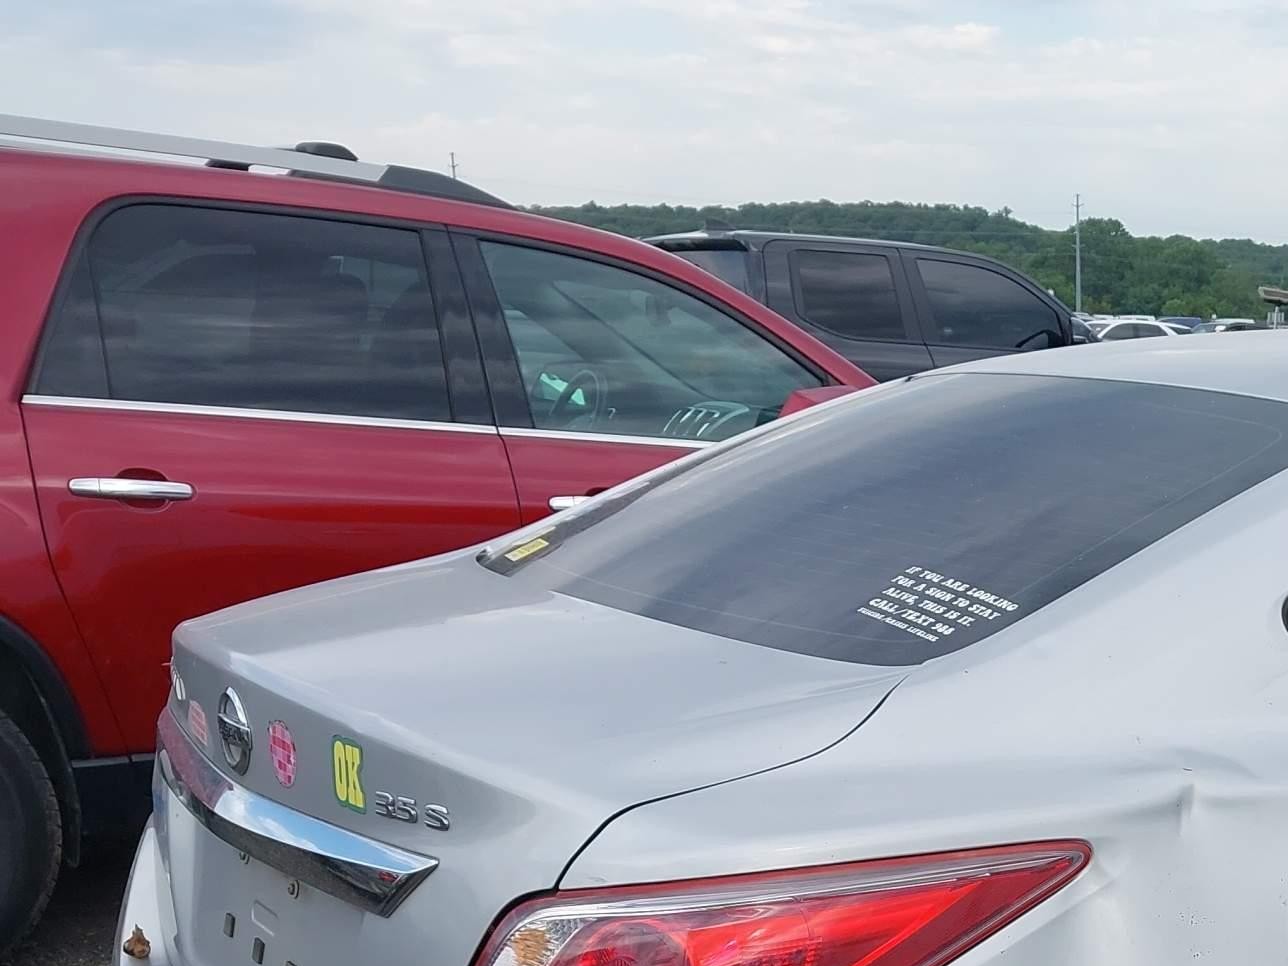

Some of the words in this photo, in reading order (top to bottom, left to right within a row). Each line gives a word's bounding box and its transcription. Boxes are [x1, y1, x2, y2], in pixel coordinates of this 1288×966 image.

[881, 587, 919, 606] ALIVE,
[917, 600, 948, 613] THIS
[942, 610, 961, 619] IS
[956, 615, 976, 626] IT.
[890, 575, 916, 588] FOR
[912, 583, 927, 591] A
[924, 587, 956, 601] SIGN
[951, 597, 970, 607] TO
[967, 603, 1001, 619] STAY
[905, 566, 922, 574] IF
[919, 570, 944, 582] YOU
[941, 578, 970, 591] ARE
[966, 587, 1019, 611] LOOKING
[333, 740, 364, 808] OK
[423, 803, 450, 832] S
